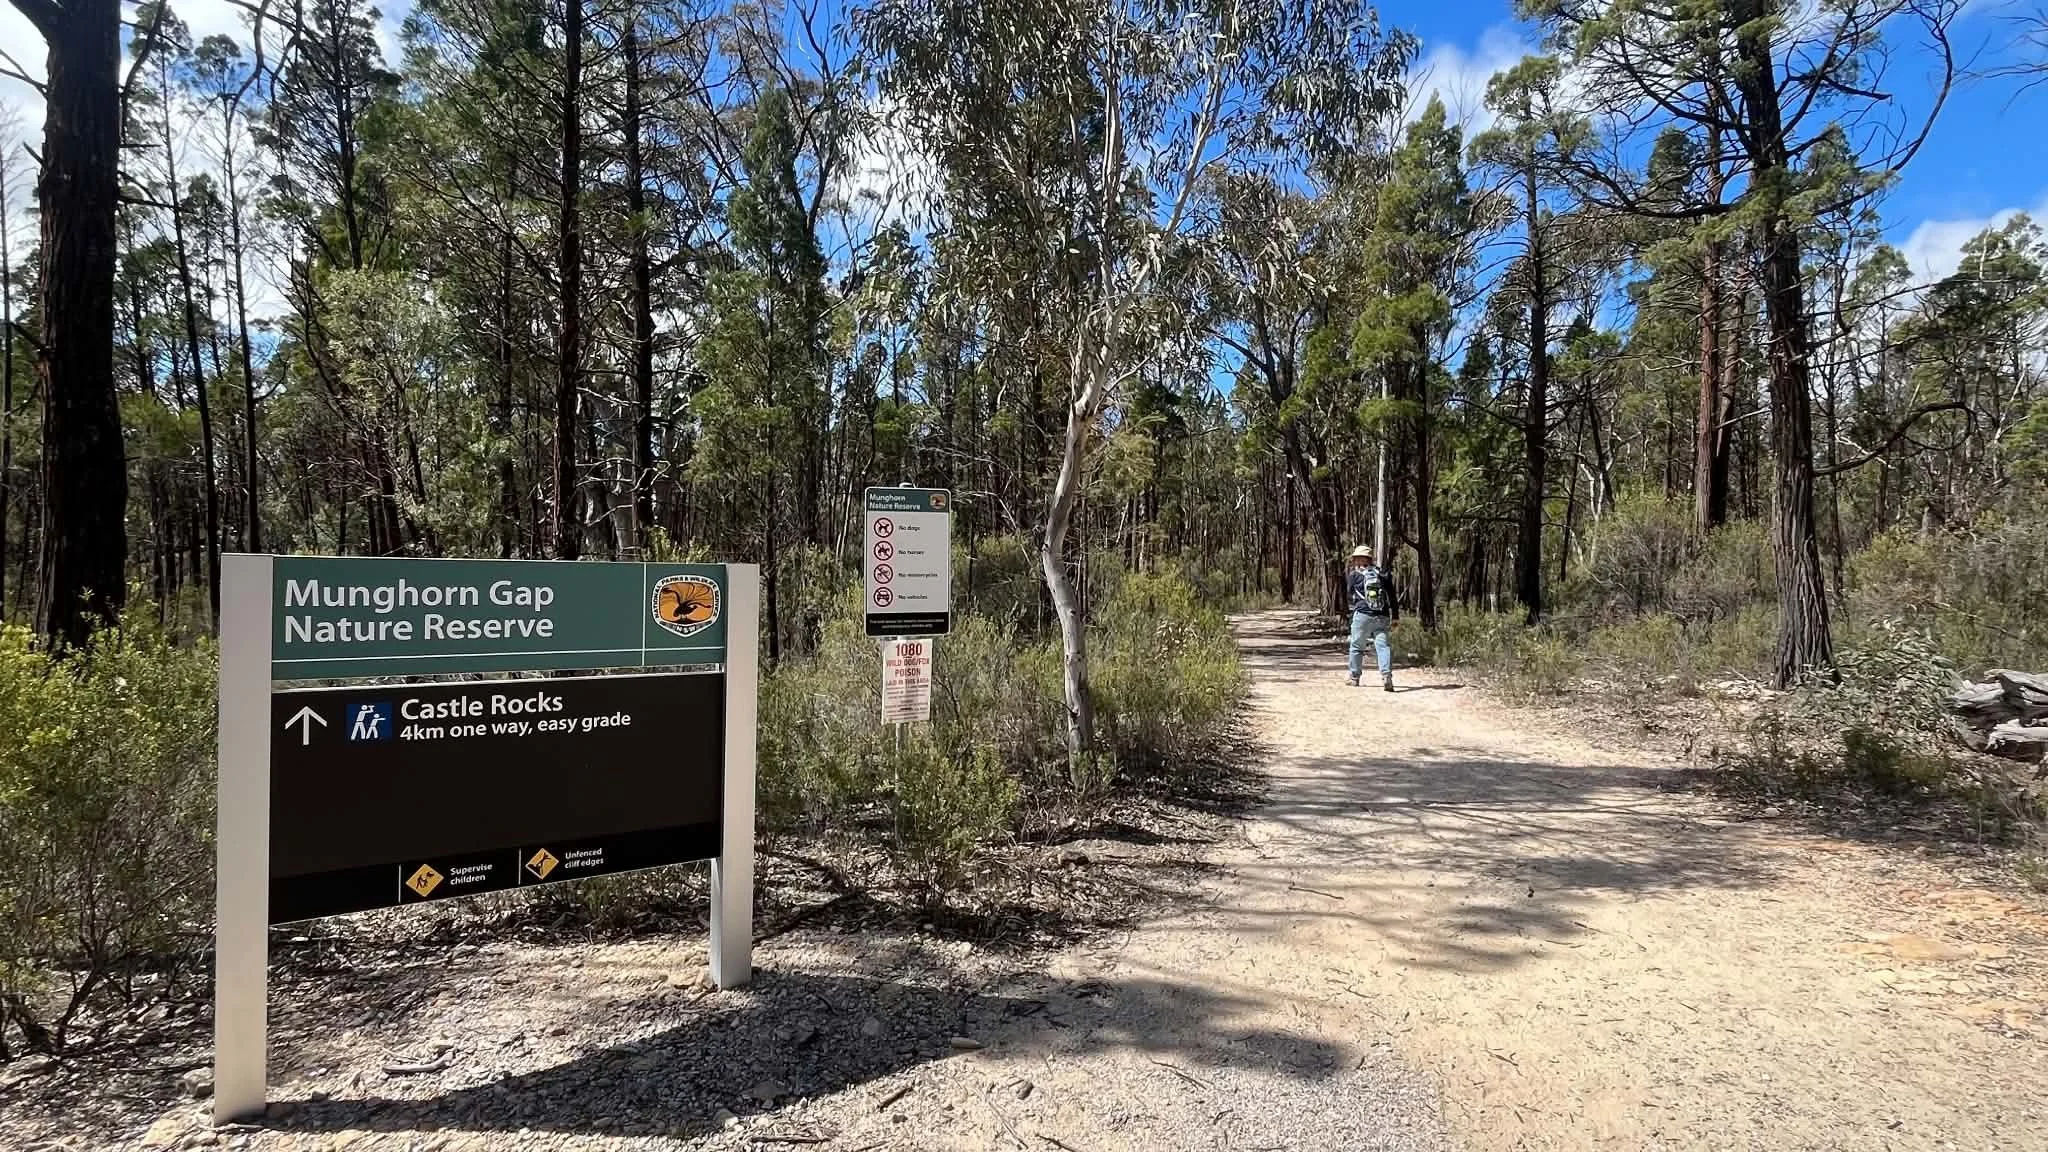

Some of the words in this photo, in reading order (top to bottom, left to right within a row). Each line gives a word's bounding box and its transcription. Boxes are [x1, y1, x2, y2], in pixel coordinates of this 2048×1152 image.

[869, 494, 906, 502] Munghorn
[869, 502, 893, 510] Nature
[285, 579, 479, 613] Munghorn
[489, 580, 554, 612] Gap
[285, 615, 413, 643] Nature
[424, 613, 554, 640] Reserve
[895, 643, 922, 656] 1080
[895, 667, 920, 677] POISON
[401, 696, 484, 720] Castle
[491, 692, 563, 715] Rocks
[400, 724, 444, 740] 4km
[450, 723, 487, 738] one
[491, 720, 533, 736] way,
[537, 717, 578, 733] easy
[581, 712, 631, 732] grade
[565, 848, 603, 860] Unfenced
[565, 860, 581, 869] cliff
[581, 857, 604, 868] edges
[450, 863, 493, 876] Supervise
[450, 874, 486, 885] children
